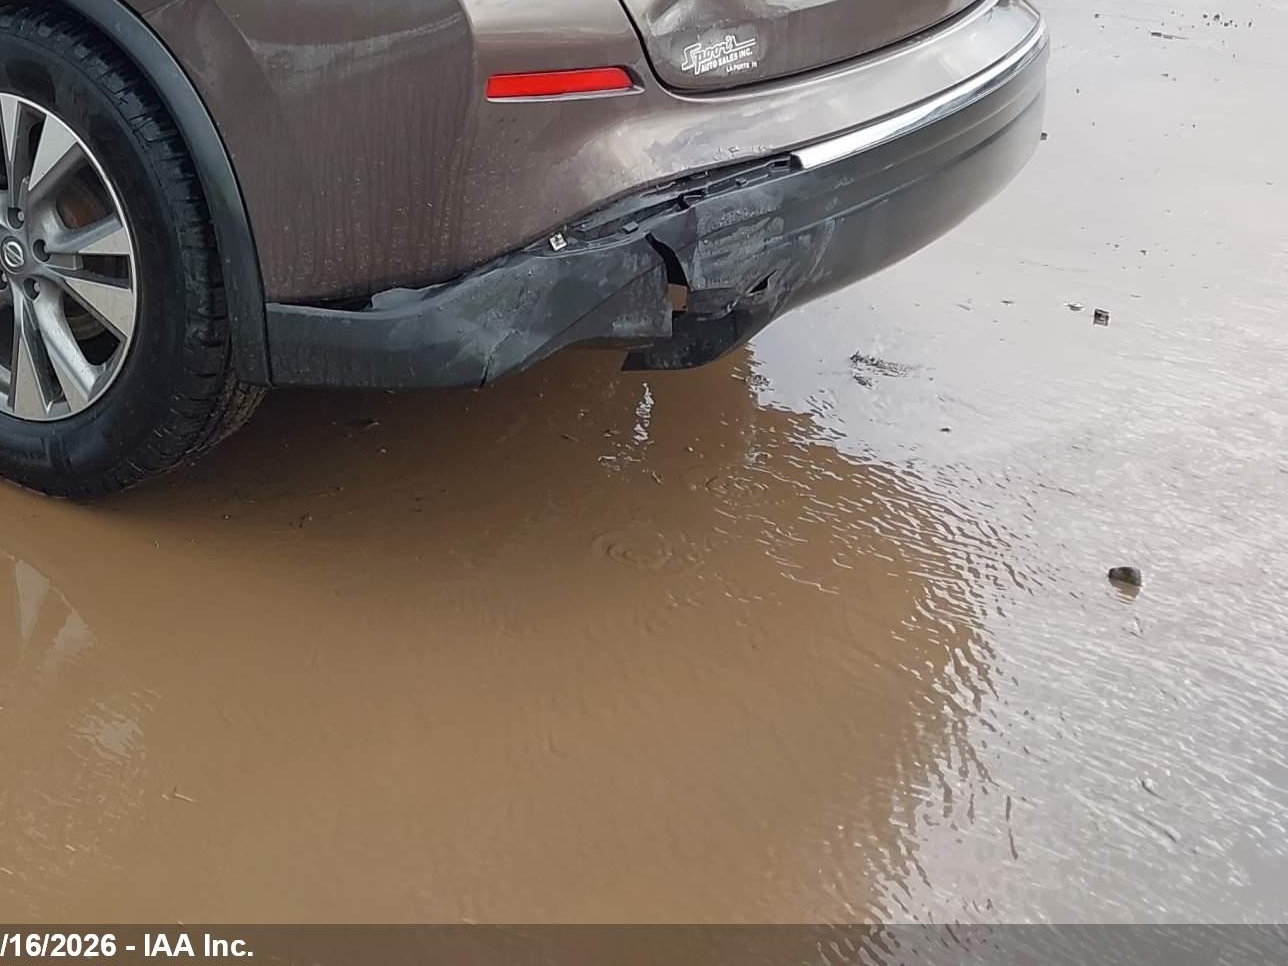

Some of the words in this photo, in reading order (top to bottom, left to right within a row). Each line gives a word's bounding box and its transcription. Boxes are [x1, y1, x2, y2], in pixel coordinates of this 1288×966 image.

[701, 61, 718, 73] AUTO
[718, 52, 738, 67] SALES
[739, 47, 753, 59] INC.
